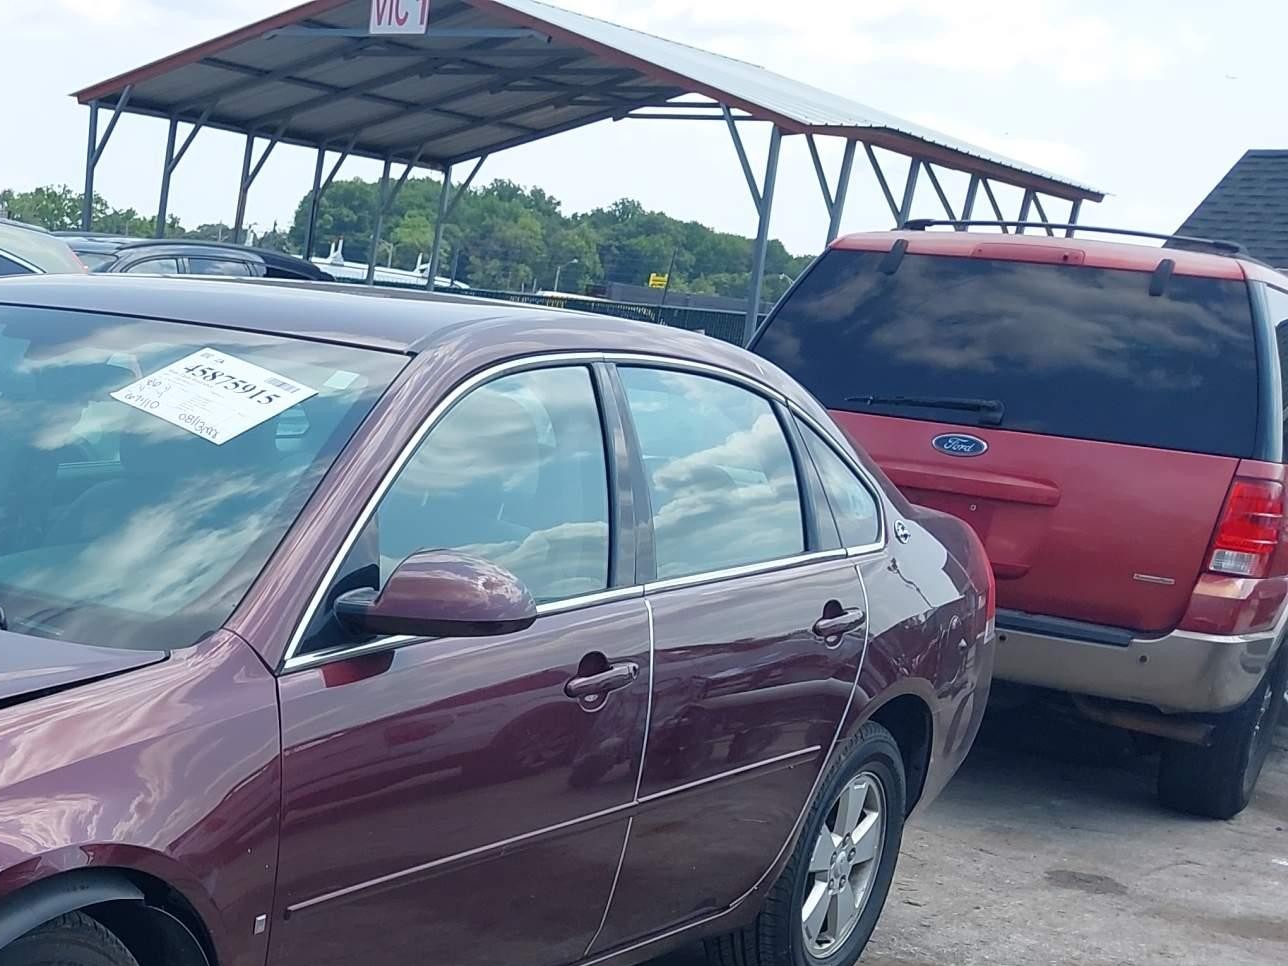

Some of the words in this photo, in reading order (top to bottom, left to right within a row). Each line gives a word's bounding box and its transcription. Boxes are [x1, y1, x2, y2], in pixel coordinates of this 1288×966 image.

[375, 0, 409, 26] VIC
[183, 364, 281, 406] 45875915
[943, 437, 976, 452] Ford
